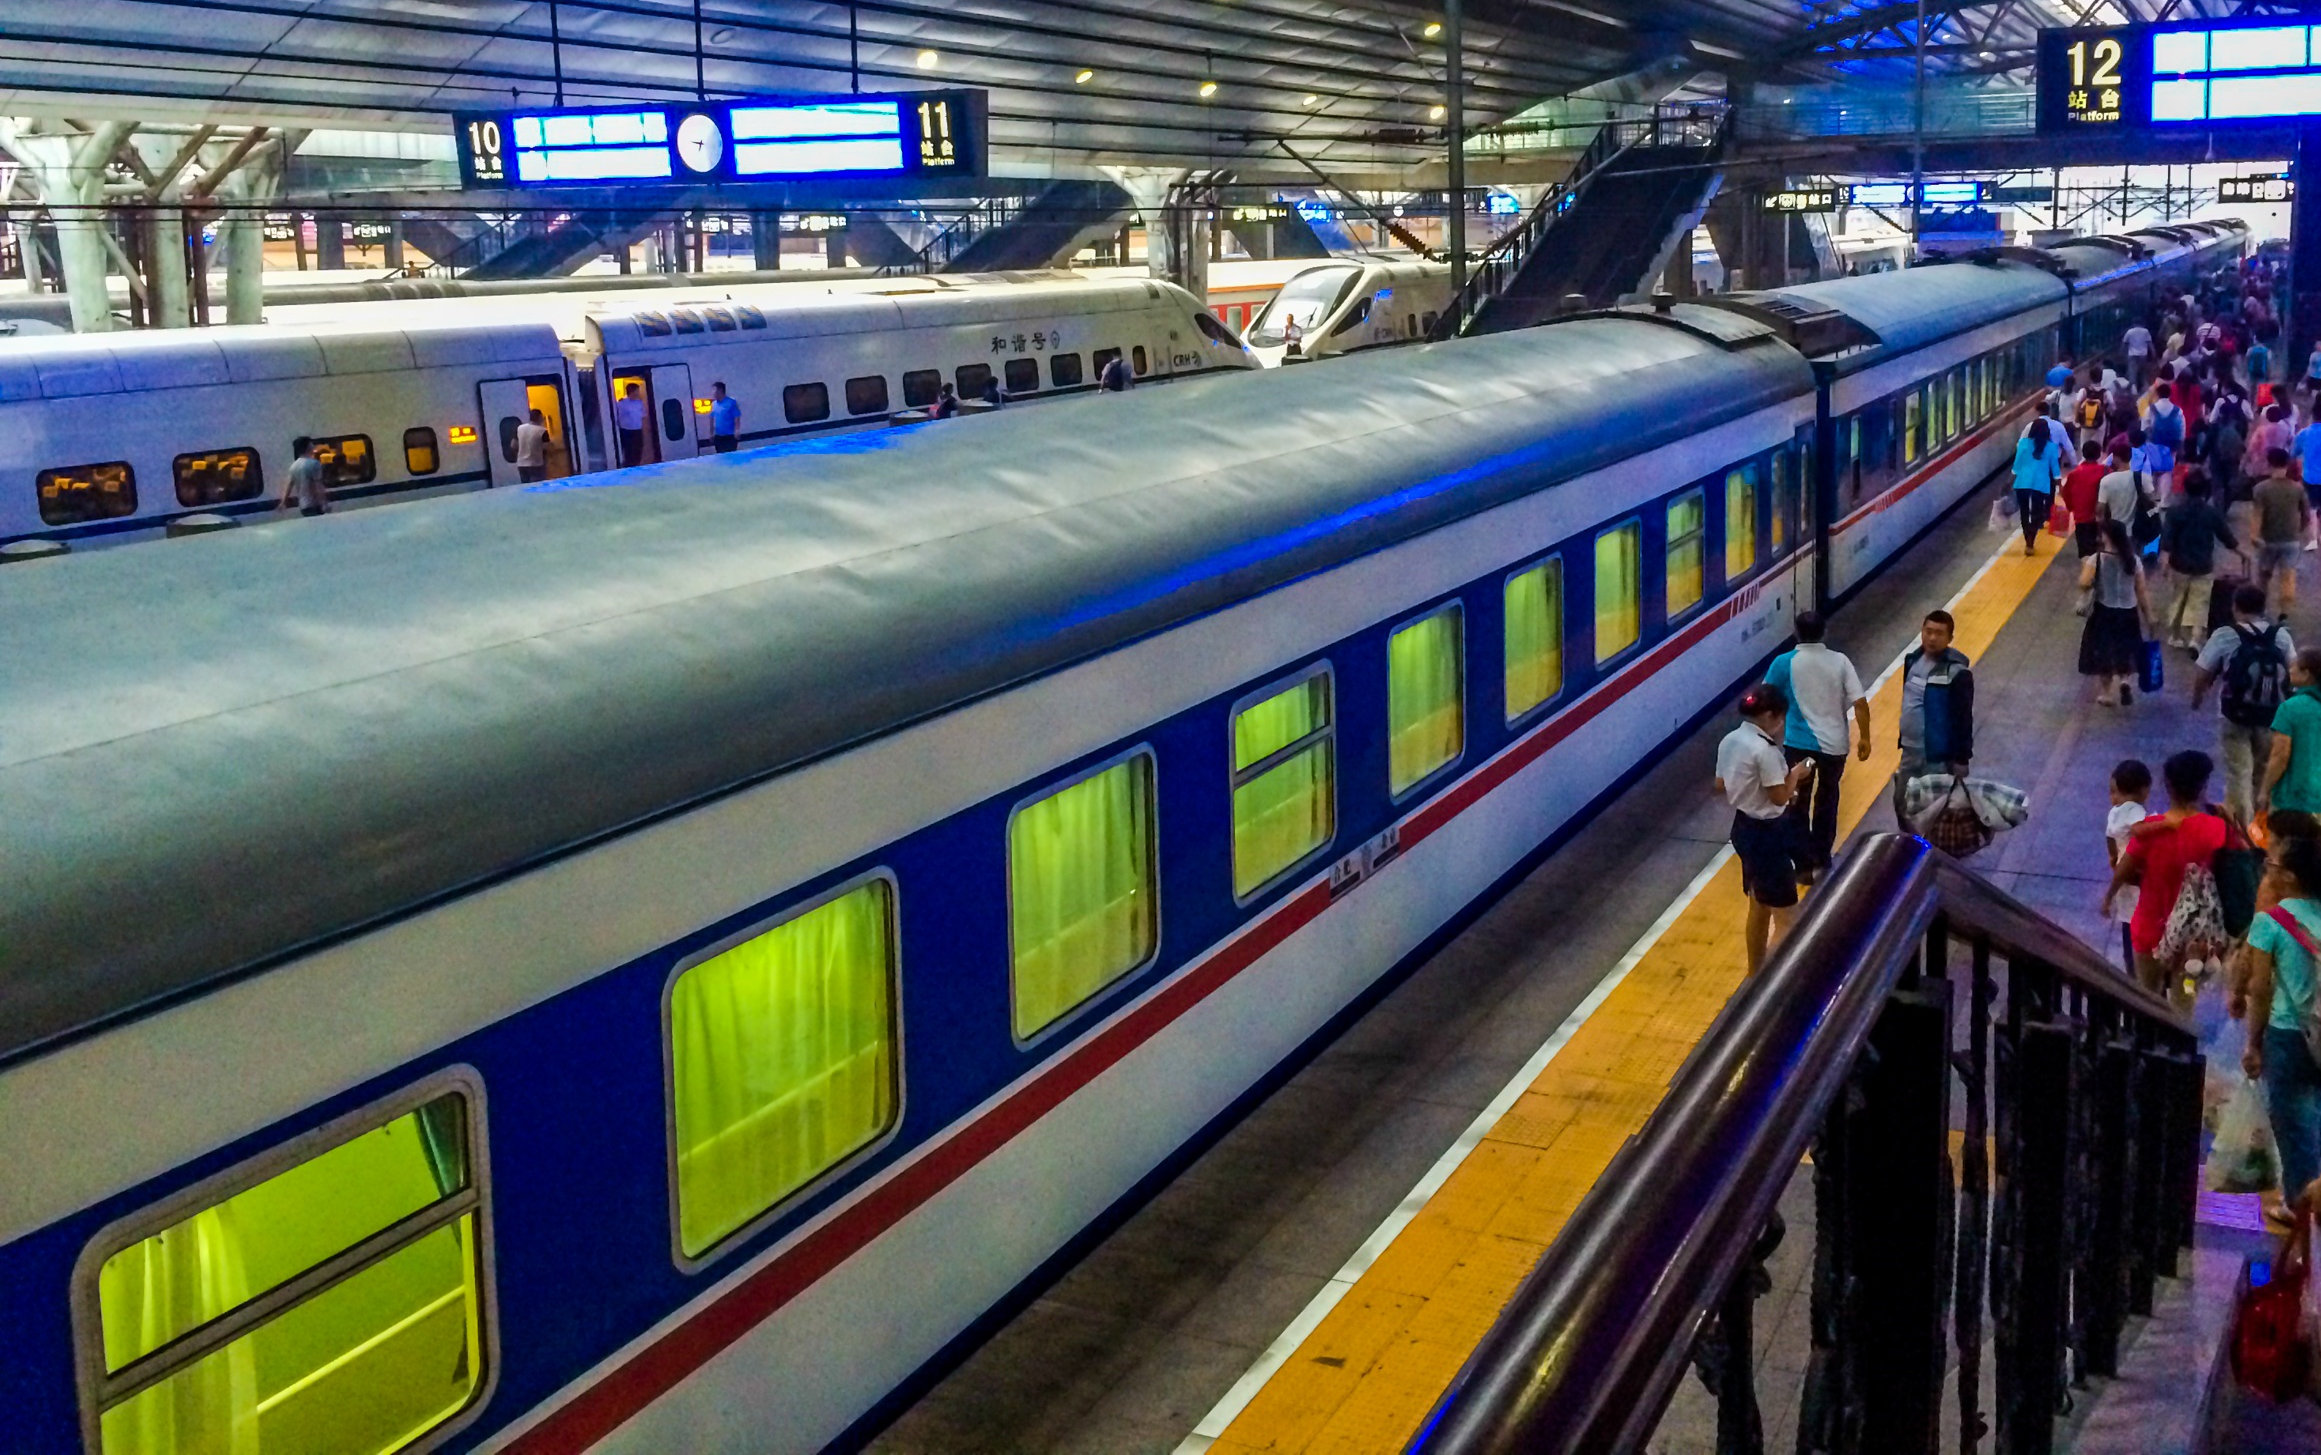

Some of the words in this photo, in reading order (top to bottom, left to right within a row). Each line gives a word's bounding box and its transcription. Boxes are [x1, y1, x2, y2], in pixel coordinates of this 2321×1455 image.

[2067, 39, 2121, 85] 12
[2068, 88, 2119, 109] 站台
[917, 101, 948, 138] 11
[2068, 110, 2119, 121] Platform
[468, 121, 501, 154] 10
[991, 332, 1046, 355] 和谐号
[1173, 353, 1191, 367] CRH
